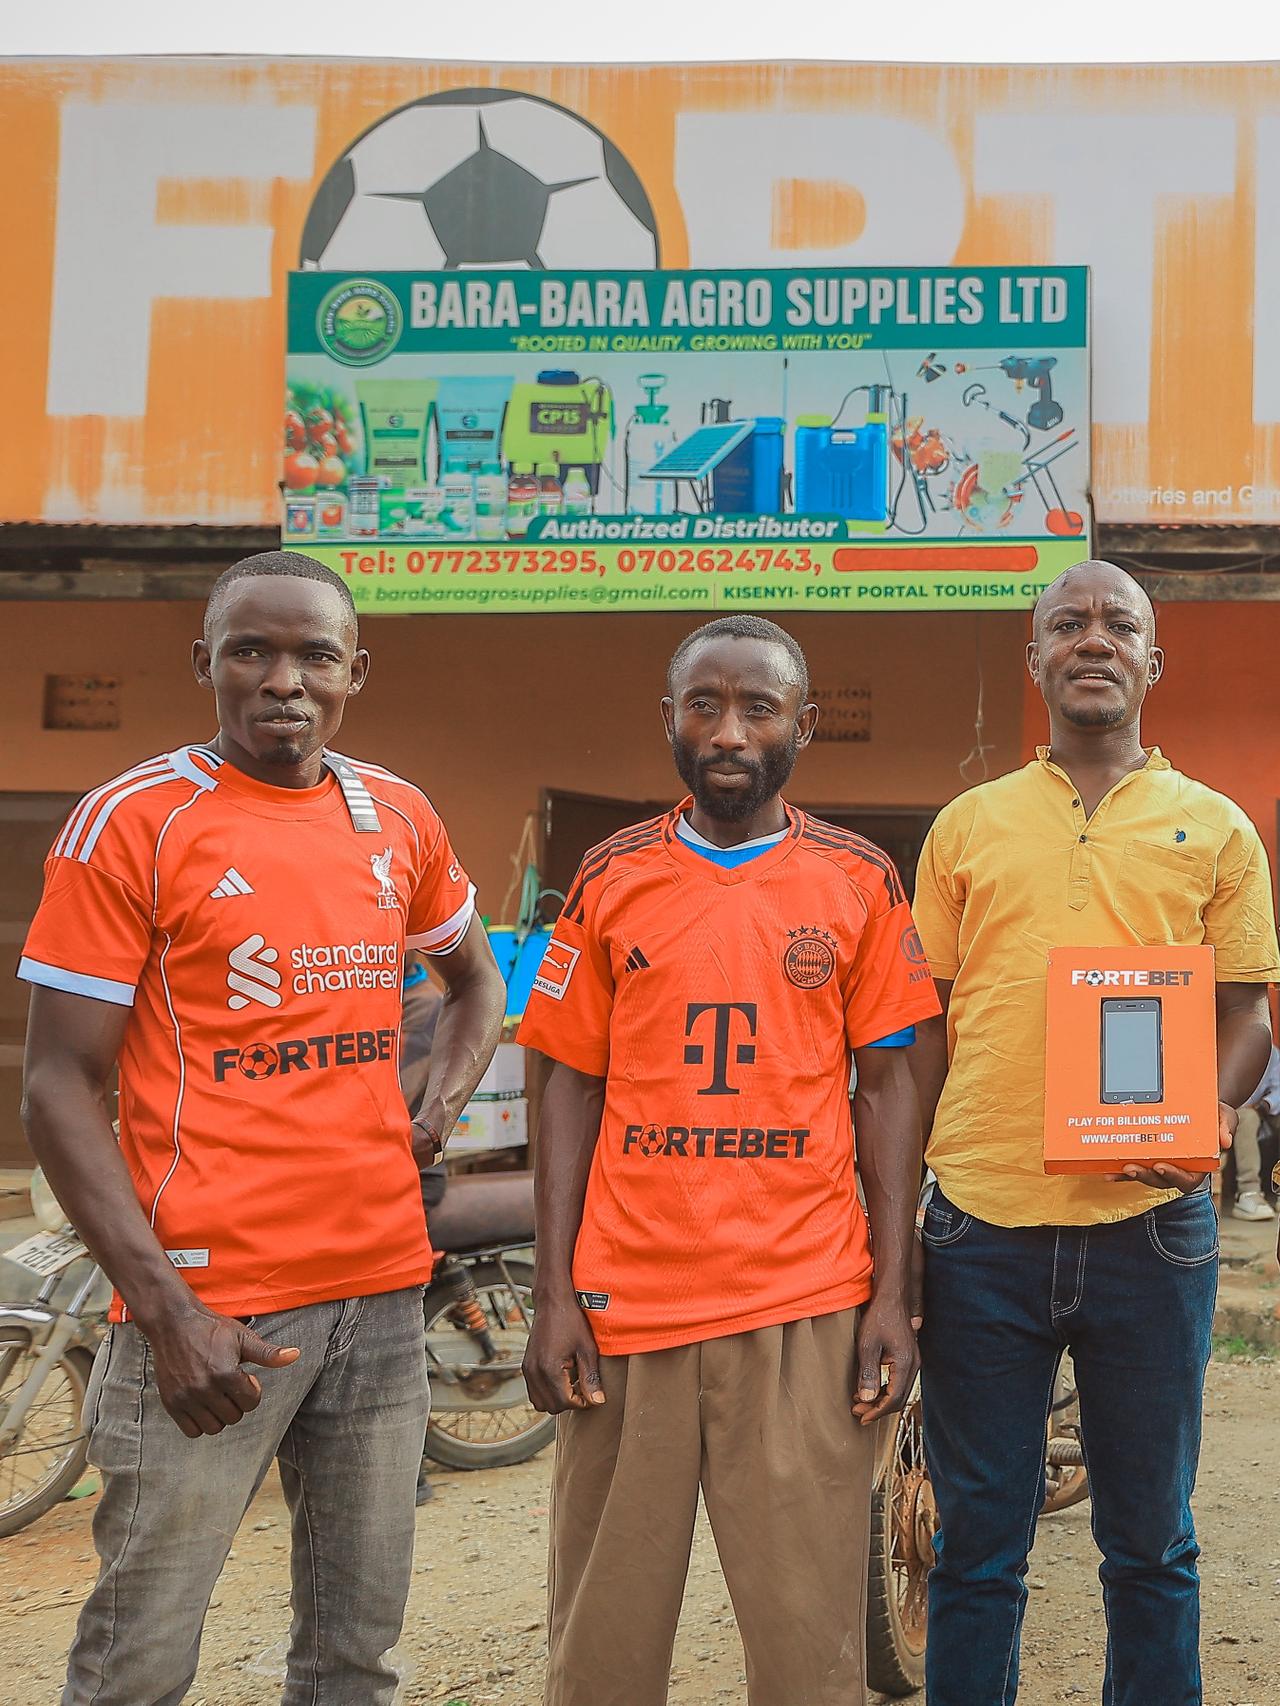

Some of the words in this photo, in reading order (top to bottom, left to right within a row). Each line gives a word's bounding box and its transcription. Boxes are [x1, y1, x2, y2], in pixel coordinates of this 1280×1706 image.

[410, 280, 649, 328] BARA-BARA
[661, 278, 772, 327] AGRO
[785, 277, 984, 326] SUPPLIES
[1000, 276, 1068, 324] LTD
[588, 335, 609, 351] IN
[690, 333, 777, 351] GROWING
[782, 333, 822, 350] WITH
[1191, 485, 1232, 504] and
[539, 517, 686, 541] Authorized
[692, 516, 840, 539] Distributor
[340, 551, 396, 576] Tel:
[406, 548, 606, 578] 0772373295,
[617, 547, 822, 577] 0702624743,
[376, 585, 709, 606] barabaraagrosupplies@gmail.com
[806, 585, 853, 598] FORT
[858, 585, 928, 598] PORTAL
[935, 584, 1015, 597] TOURISM
[290, 939, 398, 969] standard
[292, 965, 399, 995] chartered
[1071, 969, 1194, 987] FORTEBET
[1067, 1117, 1093, 1127] PLAY
[1095, 1116, 1115, 1126] FOR
[1117, 1115, 1161, 1126] BILLIONS
[622, 1123, 810, 1159] FORTEBET
[1080, 1132, 1174, 1144] WWW.FORTEBET.UG
